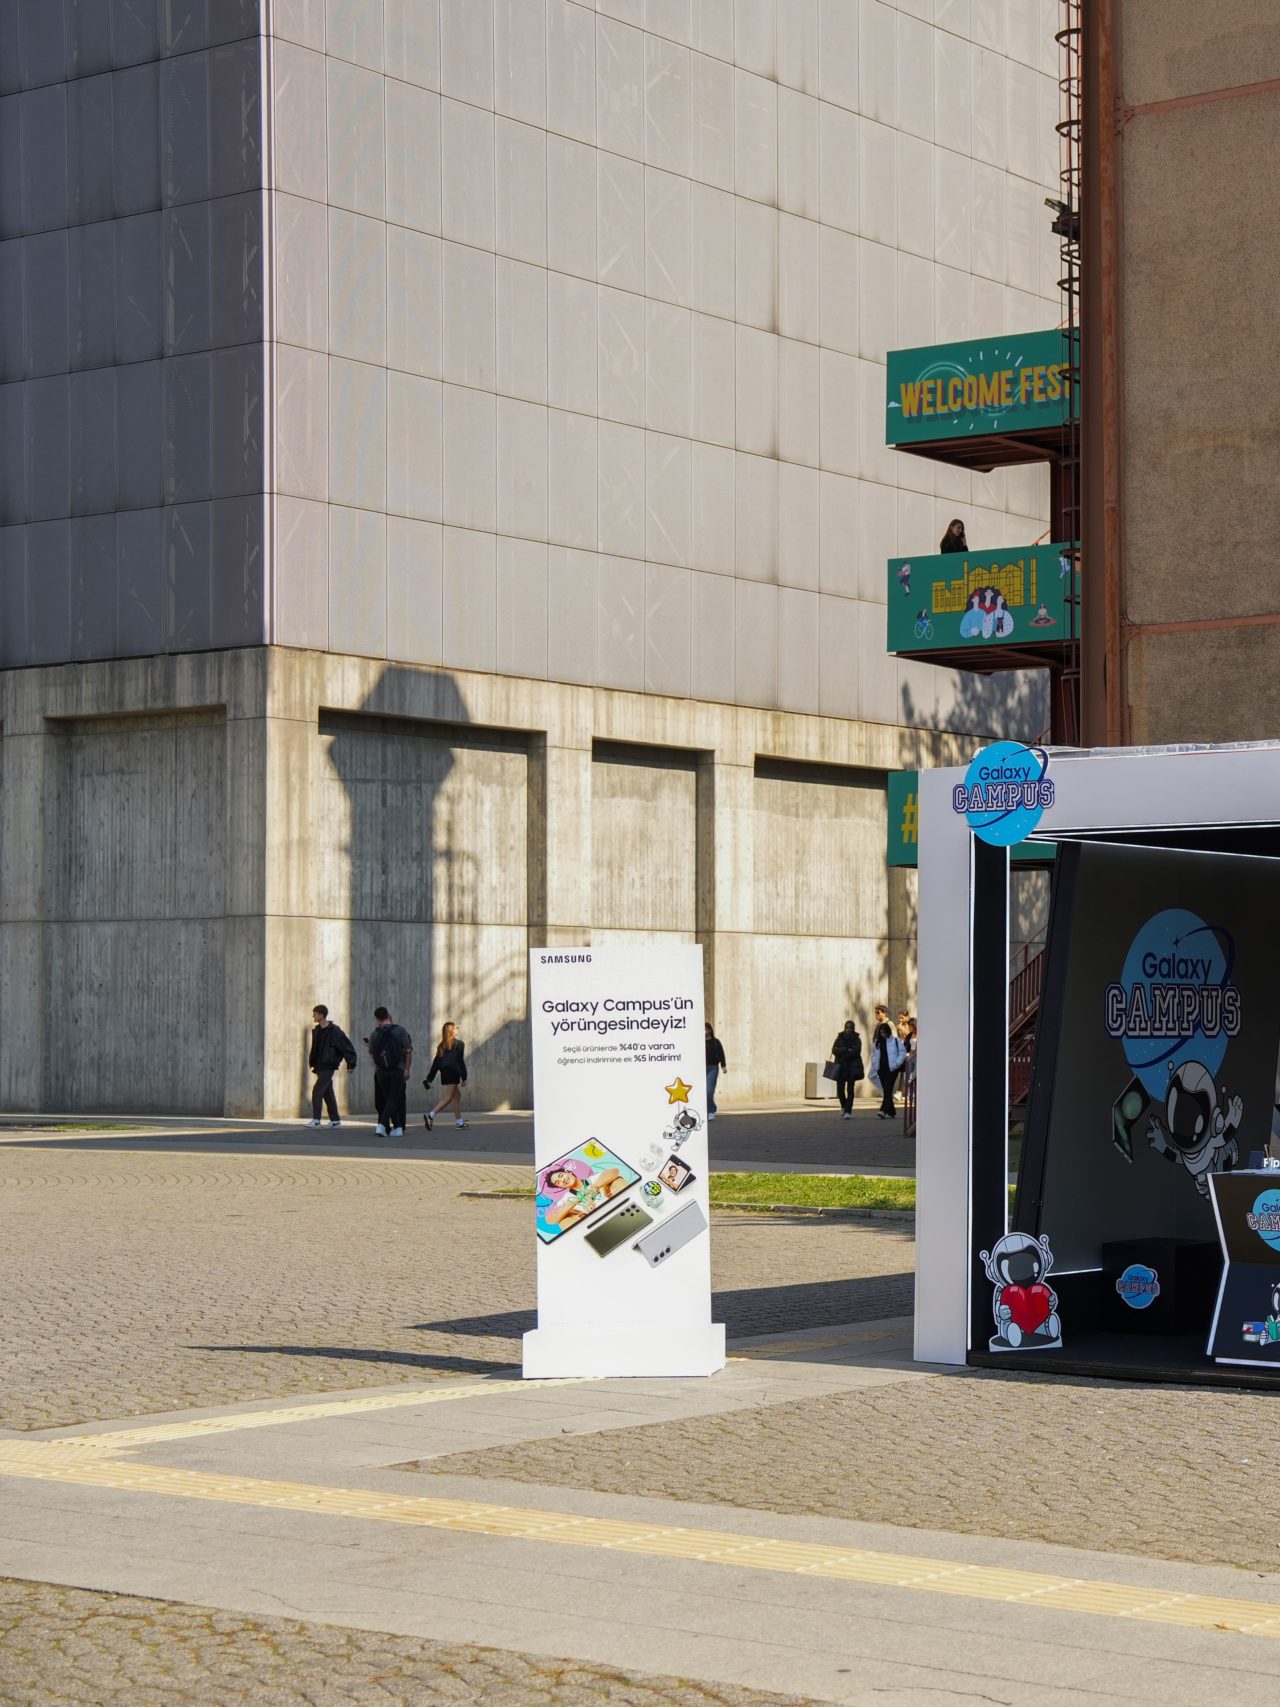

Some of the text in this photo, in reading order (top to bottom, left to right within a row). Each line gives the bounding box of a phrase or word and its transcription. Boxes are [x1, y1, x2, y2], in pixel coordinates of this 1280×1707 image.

[900, 369, 1015, 417] WELCOME
[979, 765, 1031, 781] Galaxy
[952, 779, 1055, 814] CAMPUS
[540, 954, 592, 964] SAMSUNG
[1142, 952, 1212, 984] Galaxy
[542, 997, 694, 1016] Galaxy Campus'ün
[1104, 982, 1242, 1039] CAMPUS
[551, 1016, 686, 1036] yörüngesindeyiz!
[562, 1045, 581, 1054] Seçili
[582, 1044, 618, 1052] ürünlerde
[619, 1043, 647, 1051] %40'a
[557, 1056, 586, 1066] öğrenci
[586, 1056, 621, 1064] indirimine
[633, 1054, 647, 1063] %5
[648, 1053, 682, 1062] indirim!
